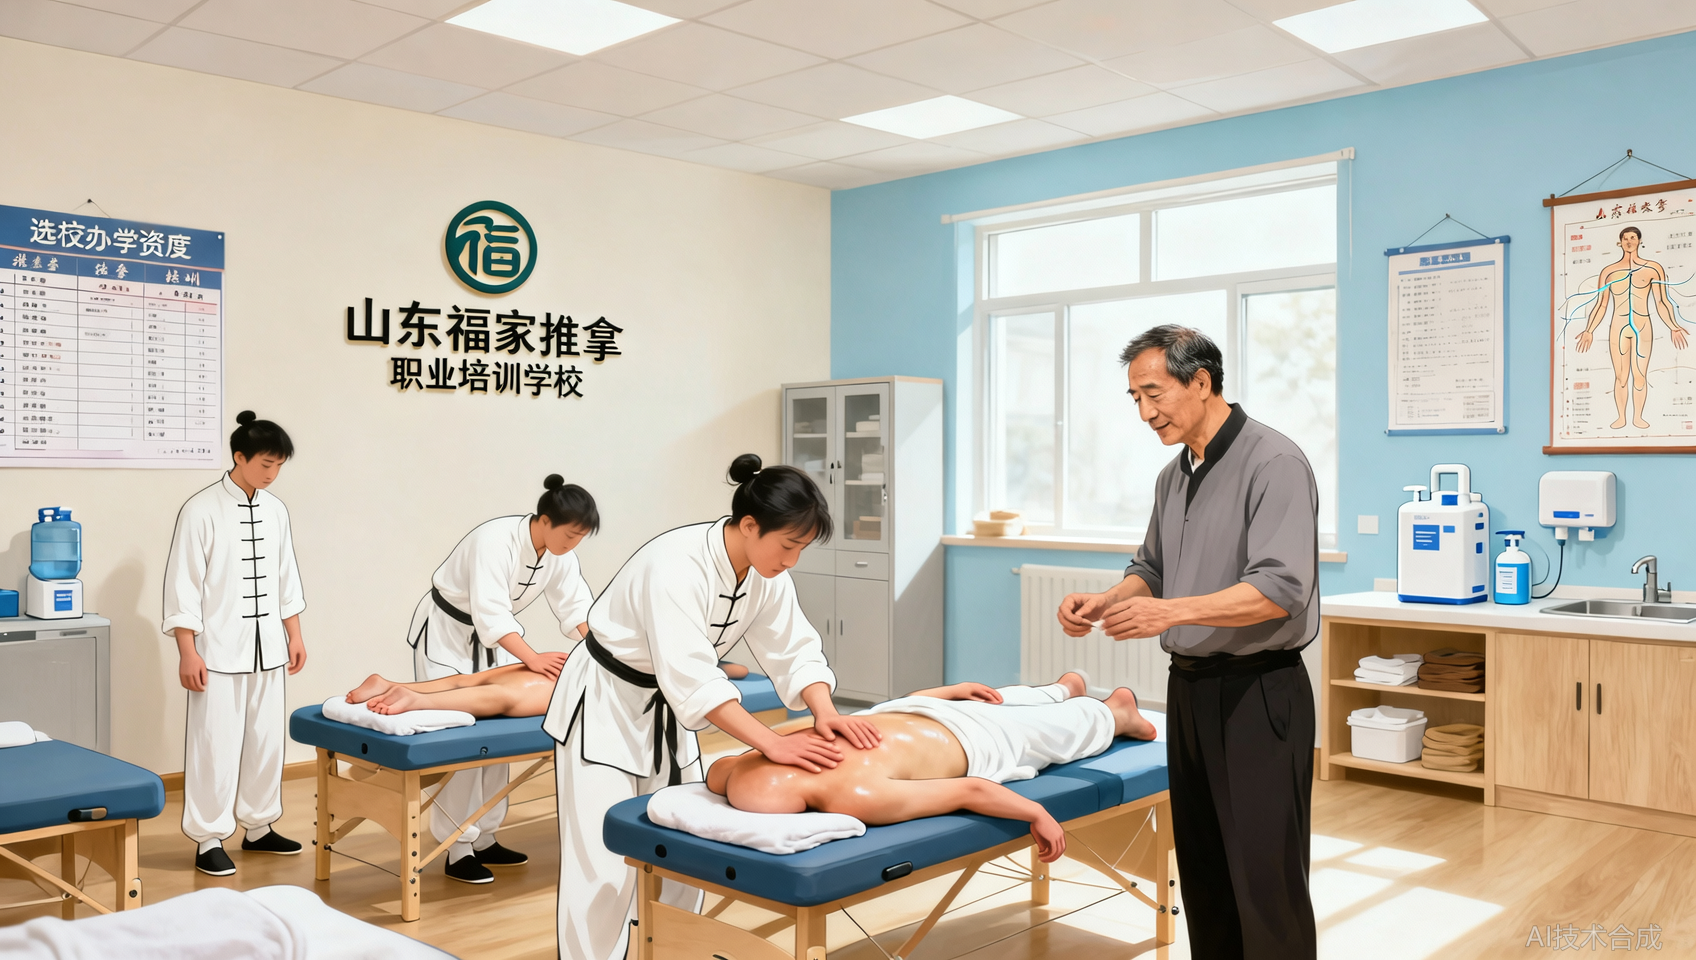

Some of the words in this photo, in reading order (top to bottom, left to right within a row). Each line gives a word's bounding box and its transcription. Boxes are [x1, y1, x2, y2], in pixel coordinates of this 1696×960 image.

[29, 217, 192, 260] 选校办学资度
[447, 213, 523, 281] 福
[347, 297, 624, 362] 山东福家推拿
[389, 357, 584, 398] 职业培训学校
